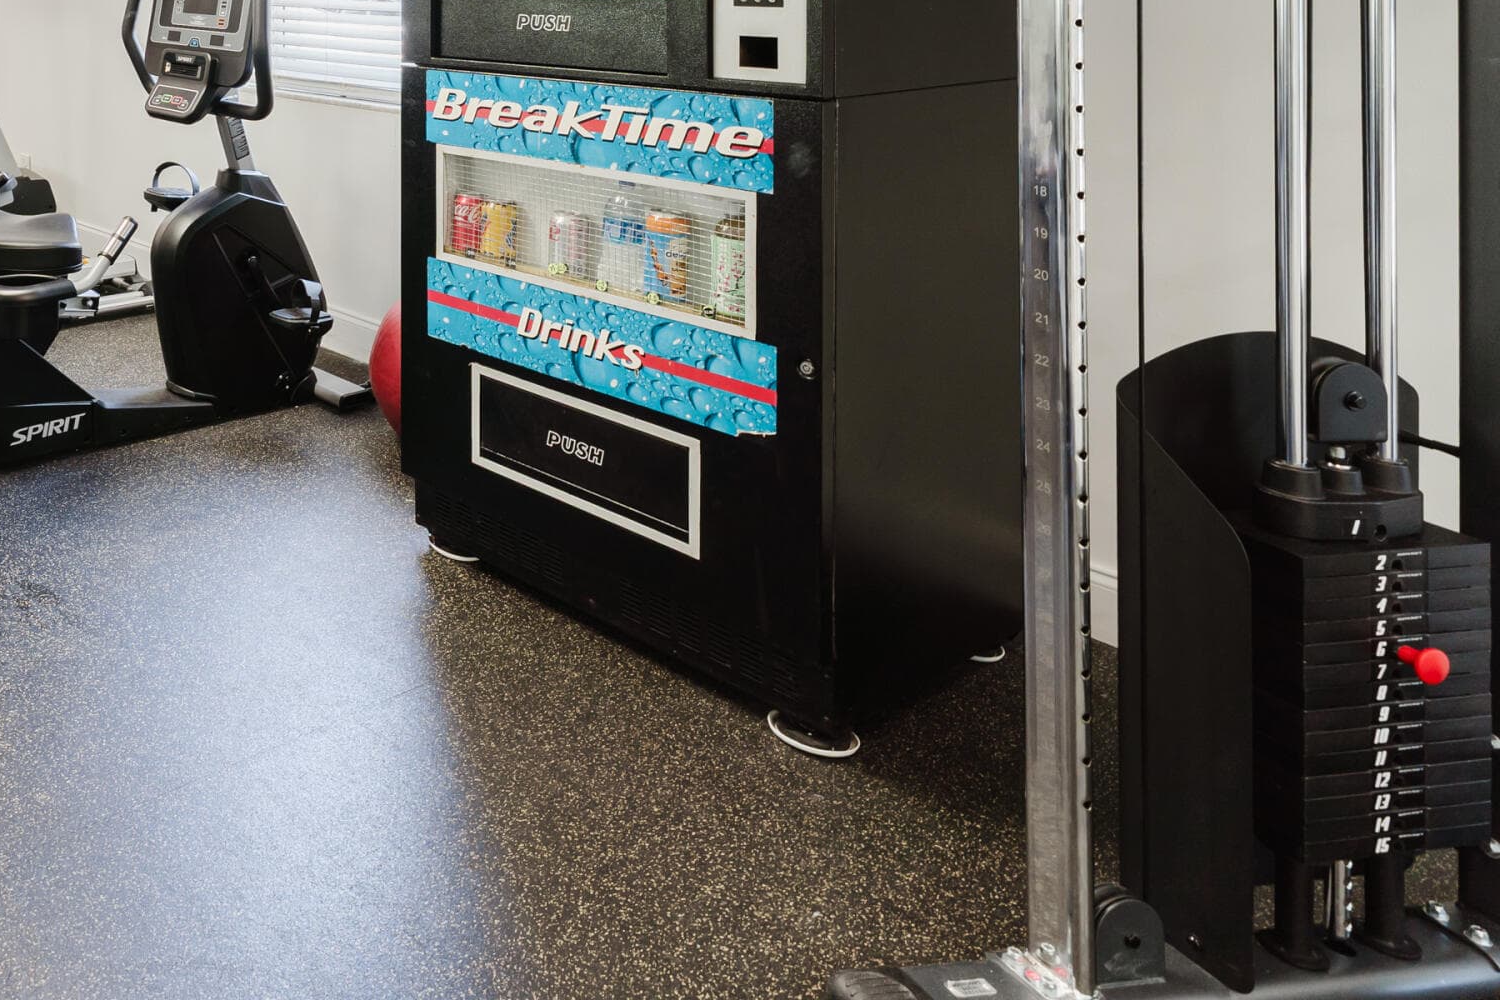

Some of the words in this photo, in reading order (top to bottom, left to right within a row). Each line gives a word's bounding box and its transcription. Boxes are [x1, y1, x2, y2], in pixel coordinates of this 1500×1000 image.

[516, 13, 572, 32] PUSH
[432, 87, 765, 159] BreakTime
[1034, 185, 1048, 197] 18
[1034, 227, 1048, 239] 19
[1034, 269, 1049, 281] 20
[1035, 312, 1049, 325] 21
[517, 306, 644, 370] Drinks
[1034, 354, 1049, 367] 22
[1036, 397, 1051, 411] 23
[10, 412, 87, 446] SPIRIT
[546, 430, 605, 466] PUSH
[1036, 439, 1050, 453] 24
[1036, 480, 1051, 494] 25
[1352, 519, 1361, 535] 1
[1375, 555, 1387, 570] 2
[1376, 576, 1387, 591] 3
[1376, 598, 1387, 613] 4
[1376, 620, 1387, 636] 5
[1376, 641, 1387, 656] 6
[1377, 664, 1387, 679] 7
[1376, 685, 1388, 700] 8
[1378, 706, 1390, 721] 9
[1374, 728, 1390, 744] 10
[1375, 751, 1387, 766] 11
[1375, 772, 1390, 788] 12
[1375, 794, 1390, 810] 13
[1375, 816, 1390, 832] 14
[1375, 837, 1391, 853] 15
